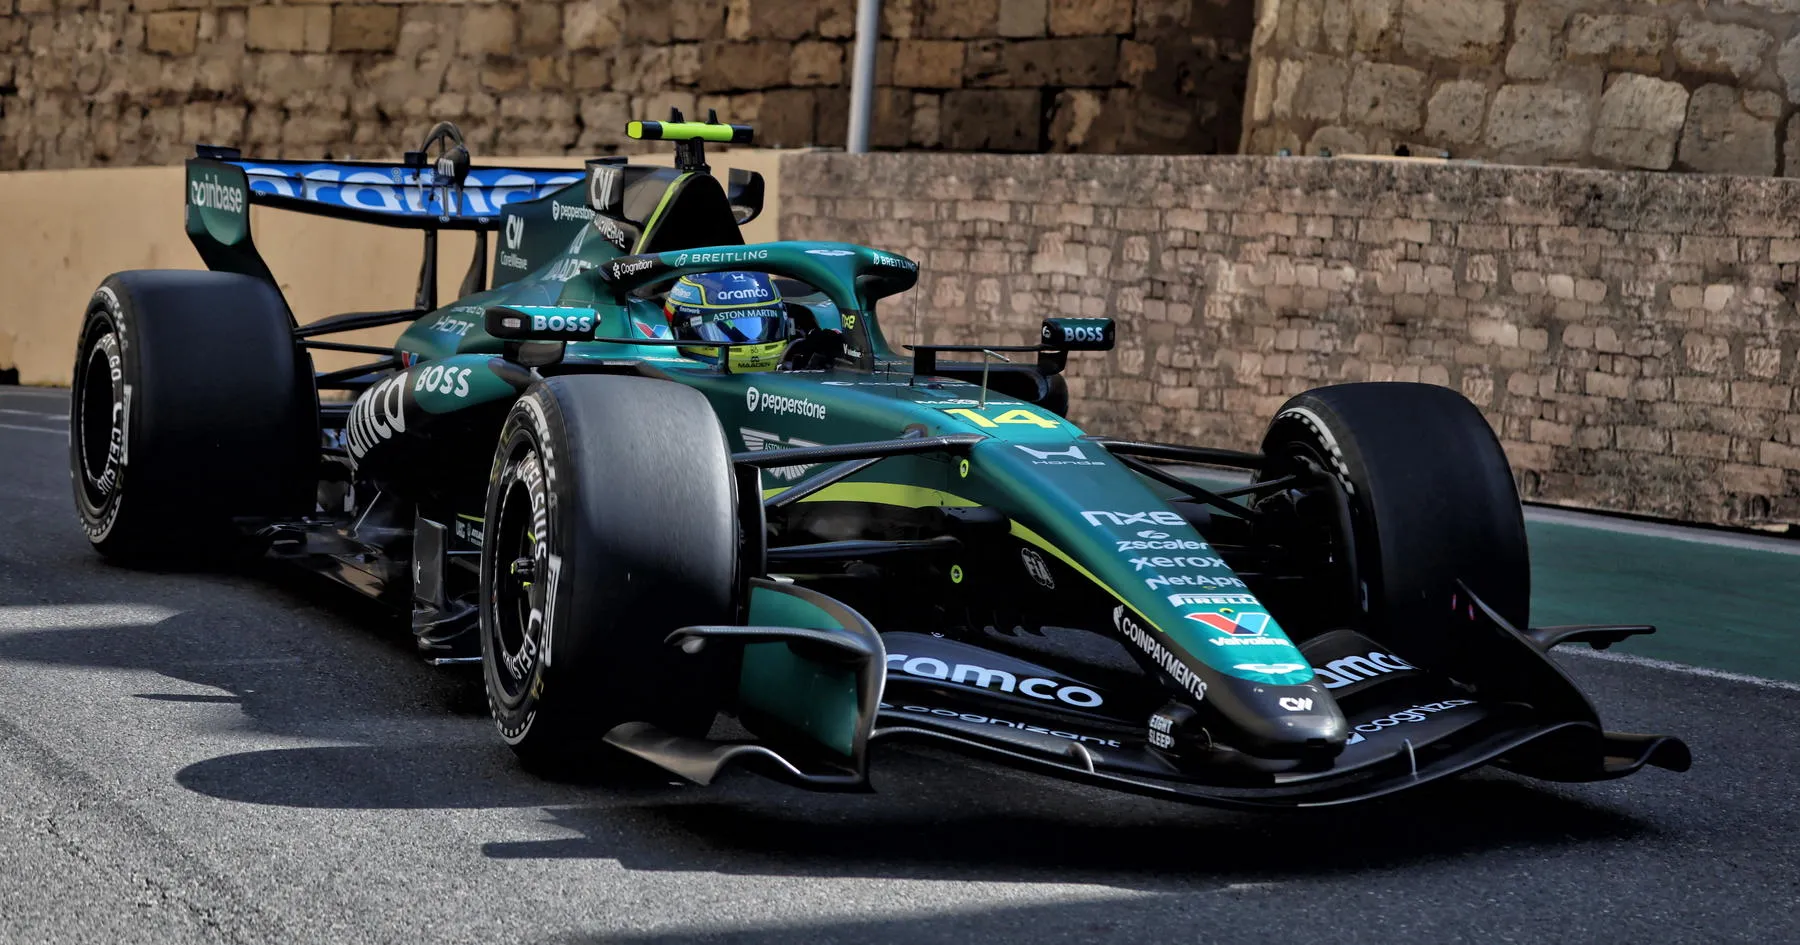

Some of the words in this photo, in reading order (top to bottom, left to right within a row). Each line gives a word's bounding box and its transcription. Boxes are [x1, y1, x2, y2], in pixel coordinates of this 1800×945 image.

[191, 173, 242, 214] coinbase
[560, 204, 596, 220] pepperstone
[692, 250, 768, 263] BREITLING
[620, 259, 652, 275] Cognition
[718, 288, 768, 300] aramco
[533, 315, 591, 332] BOSS
[713, 311, 745, 321] ASTON
[747, 308, 778, 317] MARTIN
[1063, 327, 1104, 343] BOSS
[415, 365, 472, 398] BOSS
[761, 392, 826, 420] pepperstone
[943, 408, 1060, 429] 14
[97, 426, 122, 495] CELSIUS
[522, 461, 547, 561] CELSIUS
[1081, 510, 1188, 528] nxe
[1116, 539, 1209, 552] zscaler
[1128, 556, 1232, 571] xerox
[1145, 575, 1248, 591] NetApp
[1122, 617, 1208, 701] COINPAYMENTS
[902, 705, 1121, 748] cognizant
[1149, 714, 1174, 735] EIGHT
[1148, 729, 1172, 749] SLEEP
